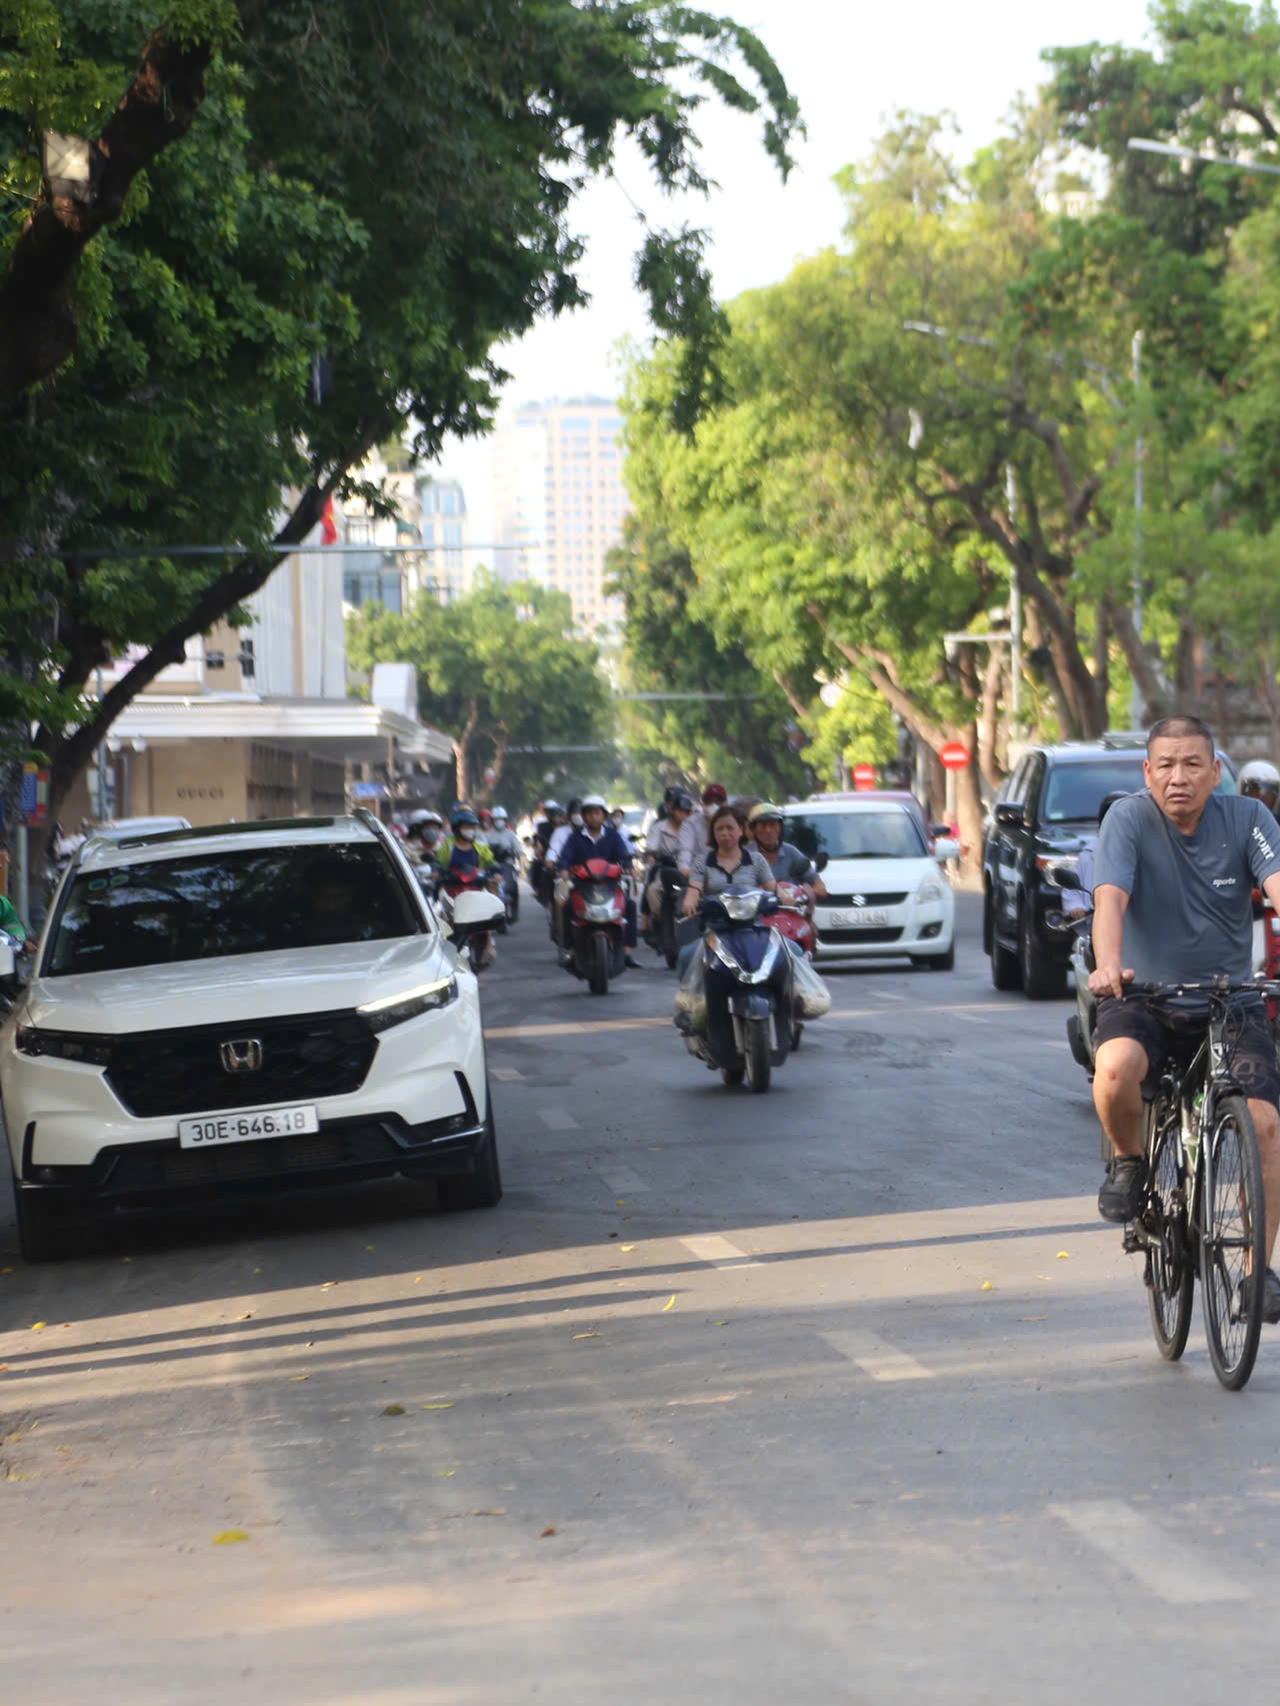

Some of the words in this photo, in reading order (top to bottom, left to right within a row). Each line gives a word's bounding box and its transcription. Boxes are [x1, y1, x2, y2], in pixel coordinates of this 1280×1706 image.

[1252, 826, 1275, 860] SPORT
[1212, 877, 1236, 888] sports
[191, 1112, 305, 1142] 30E-646.18
